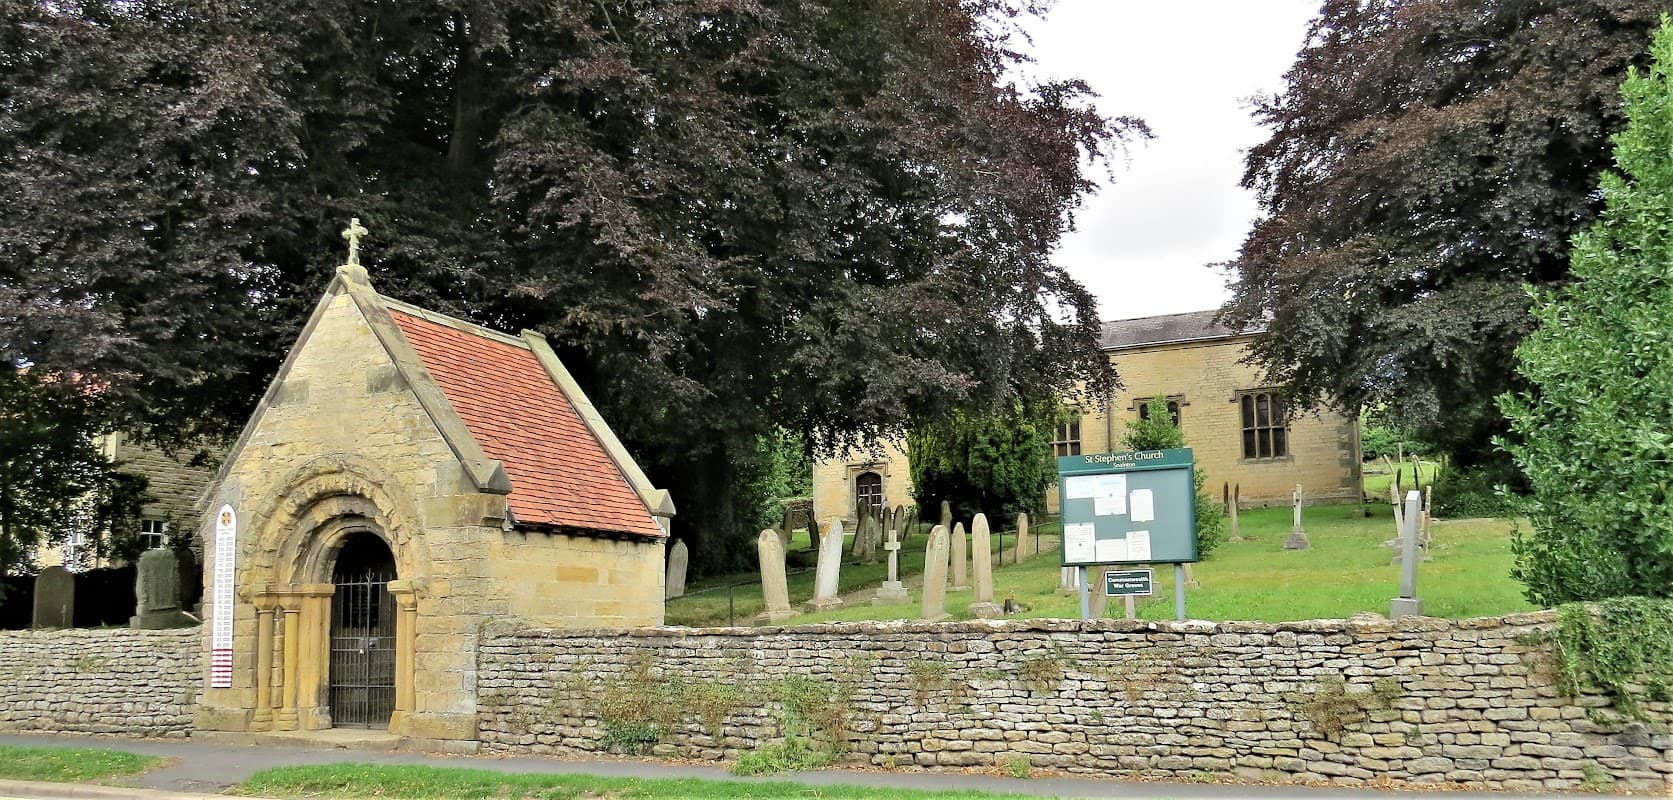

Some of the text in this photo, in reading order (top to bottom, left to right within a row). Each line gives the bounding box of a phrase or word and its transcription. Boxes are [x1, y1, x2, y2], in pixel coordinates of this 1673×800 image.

[1085, 451, 1164, 464] St Stephen's Church
